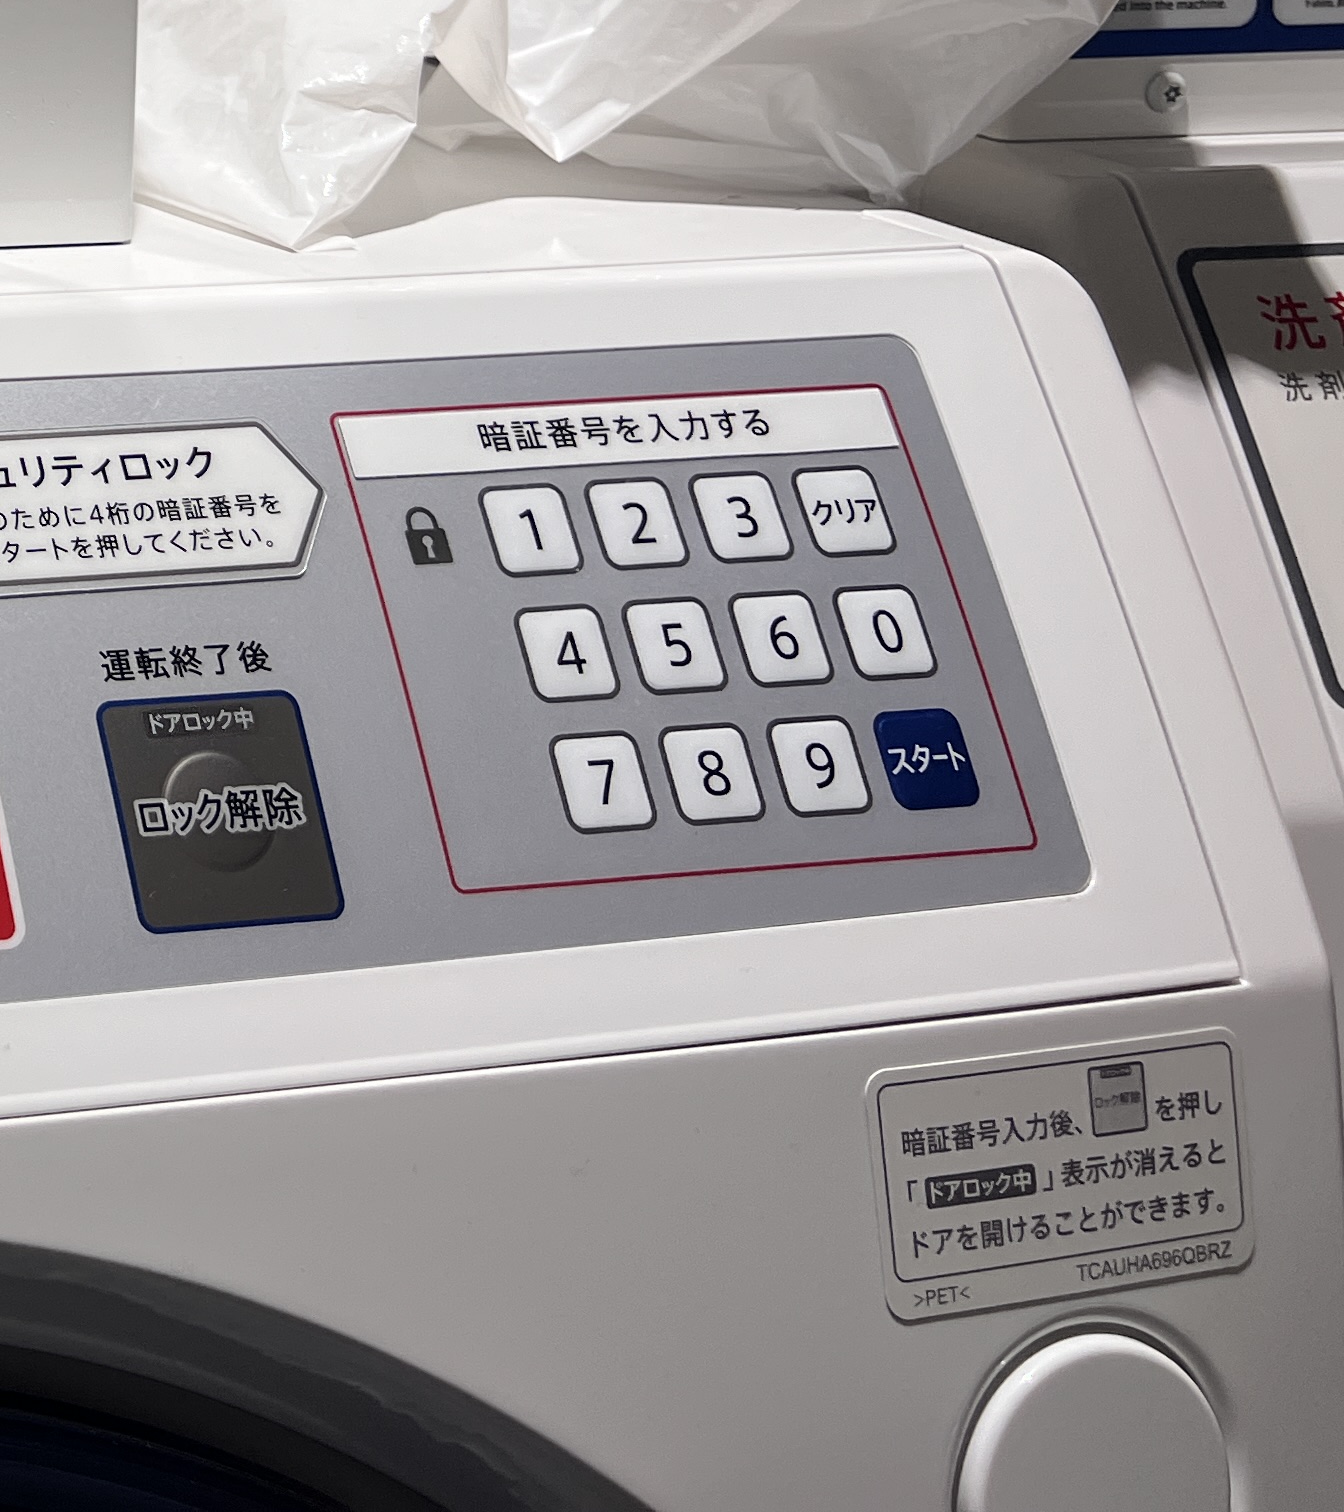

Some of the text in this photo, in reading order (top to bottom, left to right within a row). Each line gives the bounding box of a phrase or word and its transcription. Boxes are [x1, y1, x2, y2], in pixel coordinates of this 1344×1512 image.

[477, 409, 769, 452] 暗証番号を入力する
[519, 497, 876, 550] 1 2 3 クリア
[99, 641, 272, 682] 運転終了後
[558, 610, 903, 674] 4 5 6 0
[149, 707, 254, 734] ドアロック中
[588, 742, 965, 804] 7 8 9 スタート
[139, 787, 304, 833] ロック解除
[1155, 1090, 1222, 1121] を押し
[912, 1188, 1225, 1258] ドアを開けることができます。
